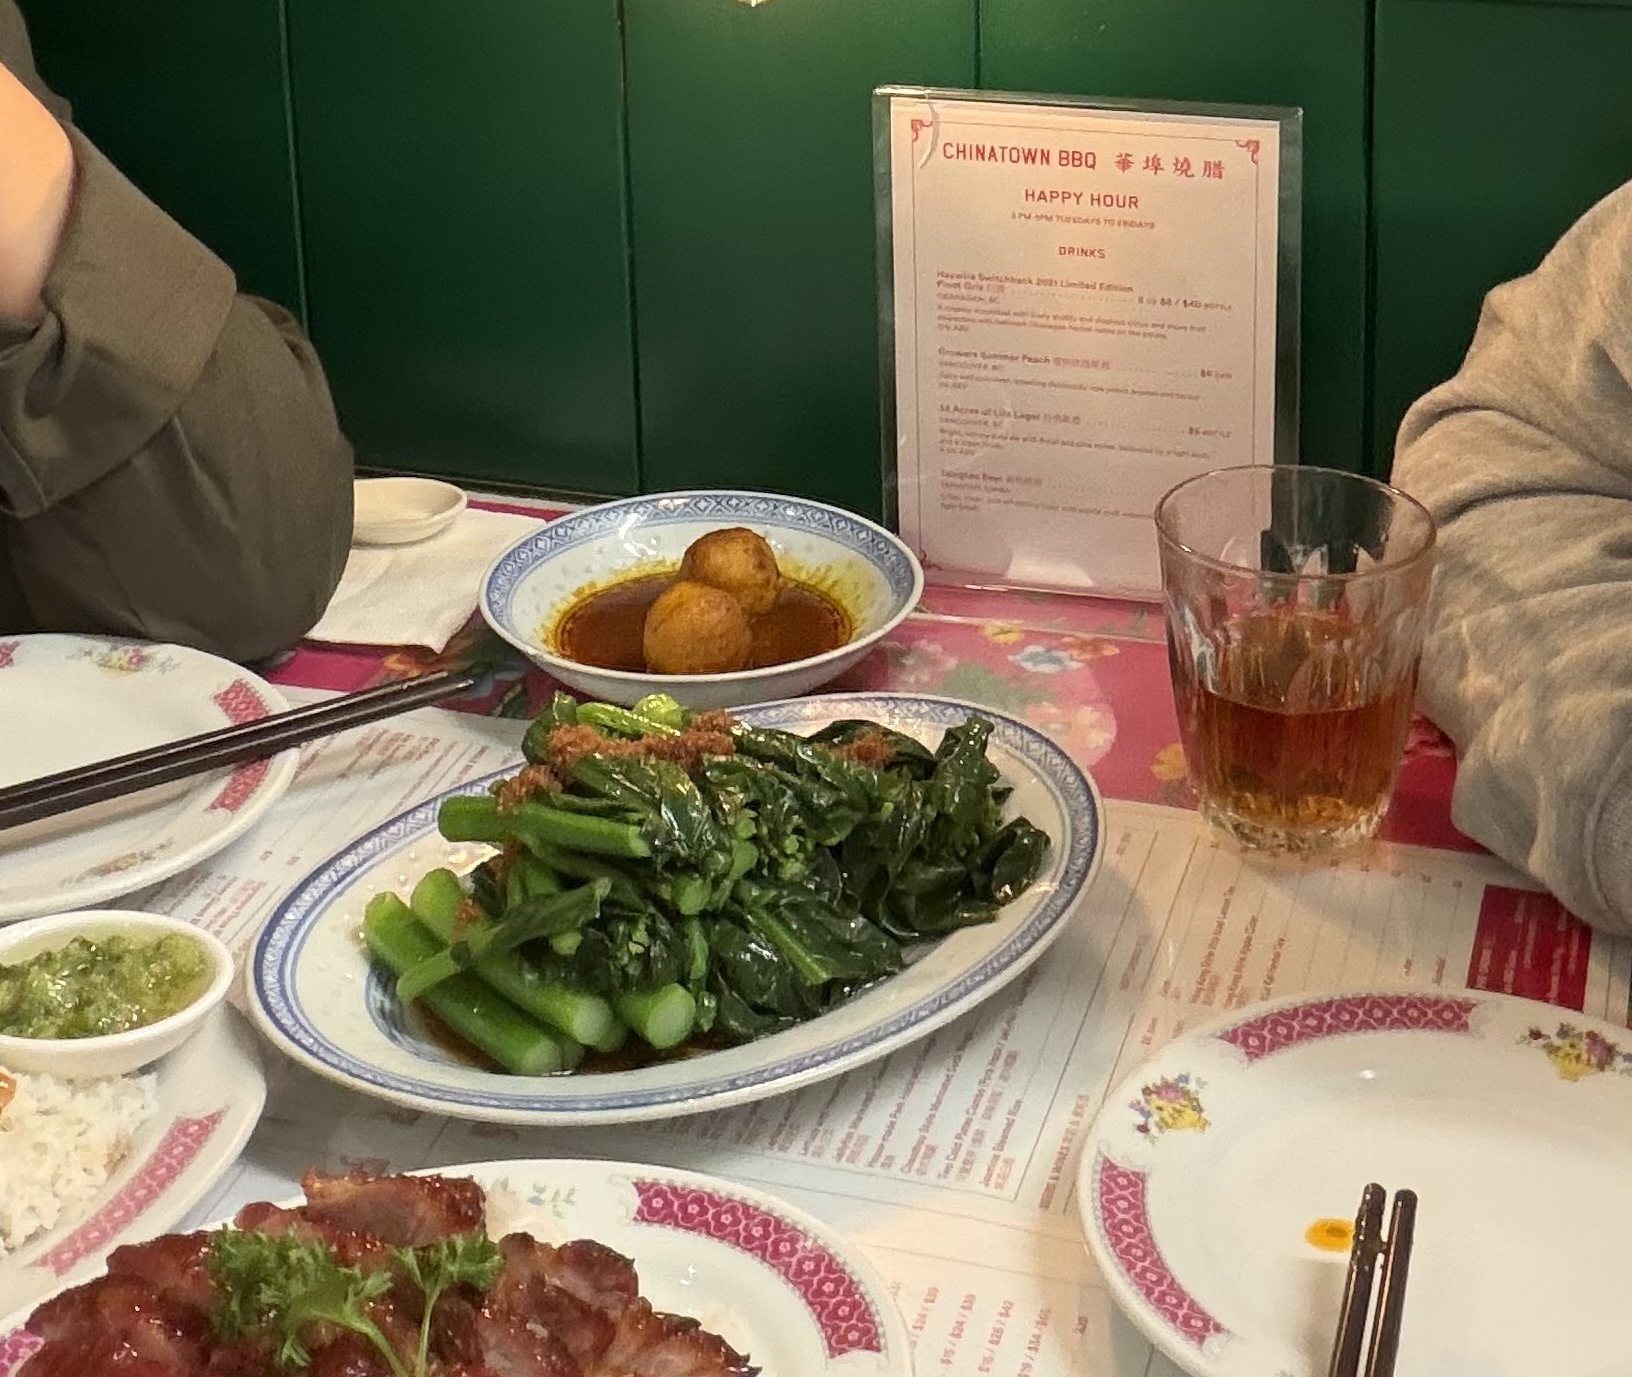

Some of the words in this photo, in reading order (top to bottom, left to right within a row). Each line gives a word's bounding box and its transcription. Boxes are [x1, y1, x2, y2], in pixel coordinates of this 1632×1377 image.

[942, 142, 1050, 166] CHINATOWN
[1058, 150, 1097, 170] BBQ
[1024, 188, 1084, 206] HAPPY
[1090, 193, 1140, 210] HOUR
[1103, 218, 1116, 228] TO
[1058, 246, 1106, 259] DRINKS
[1060, 278, 1096, 291] Limited
